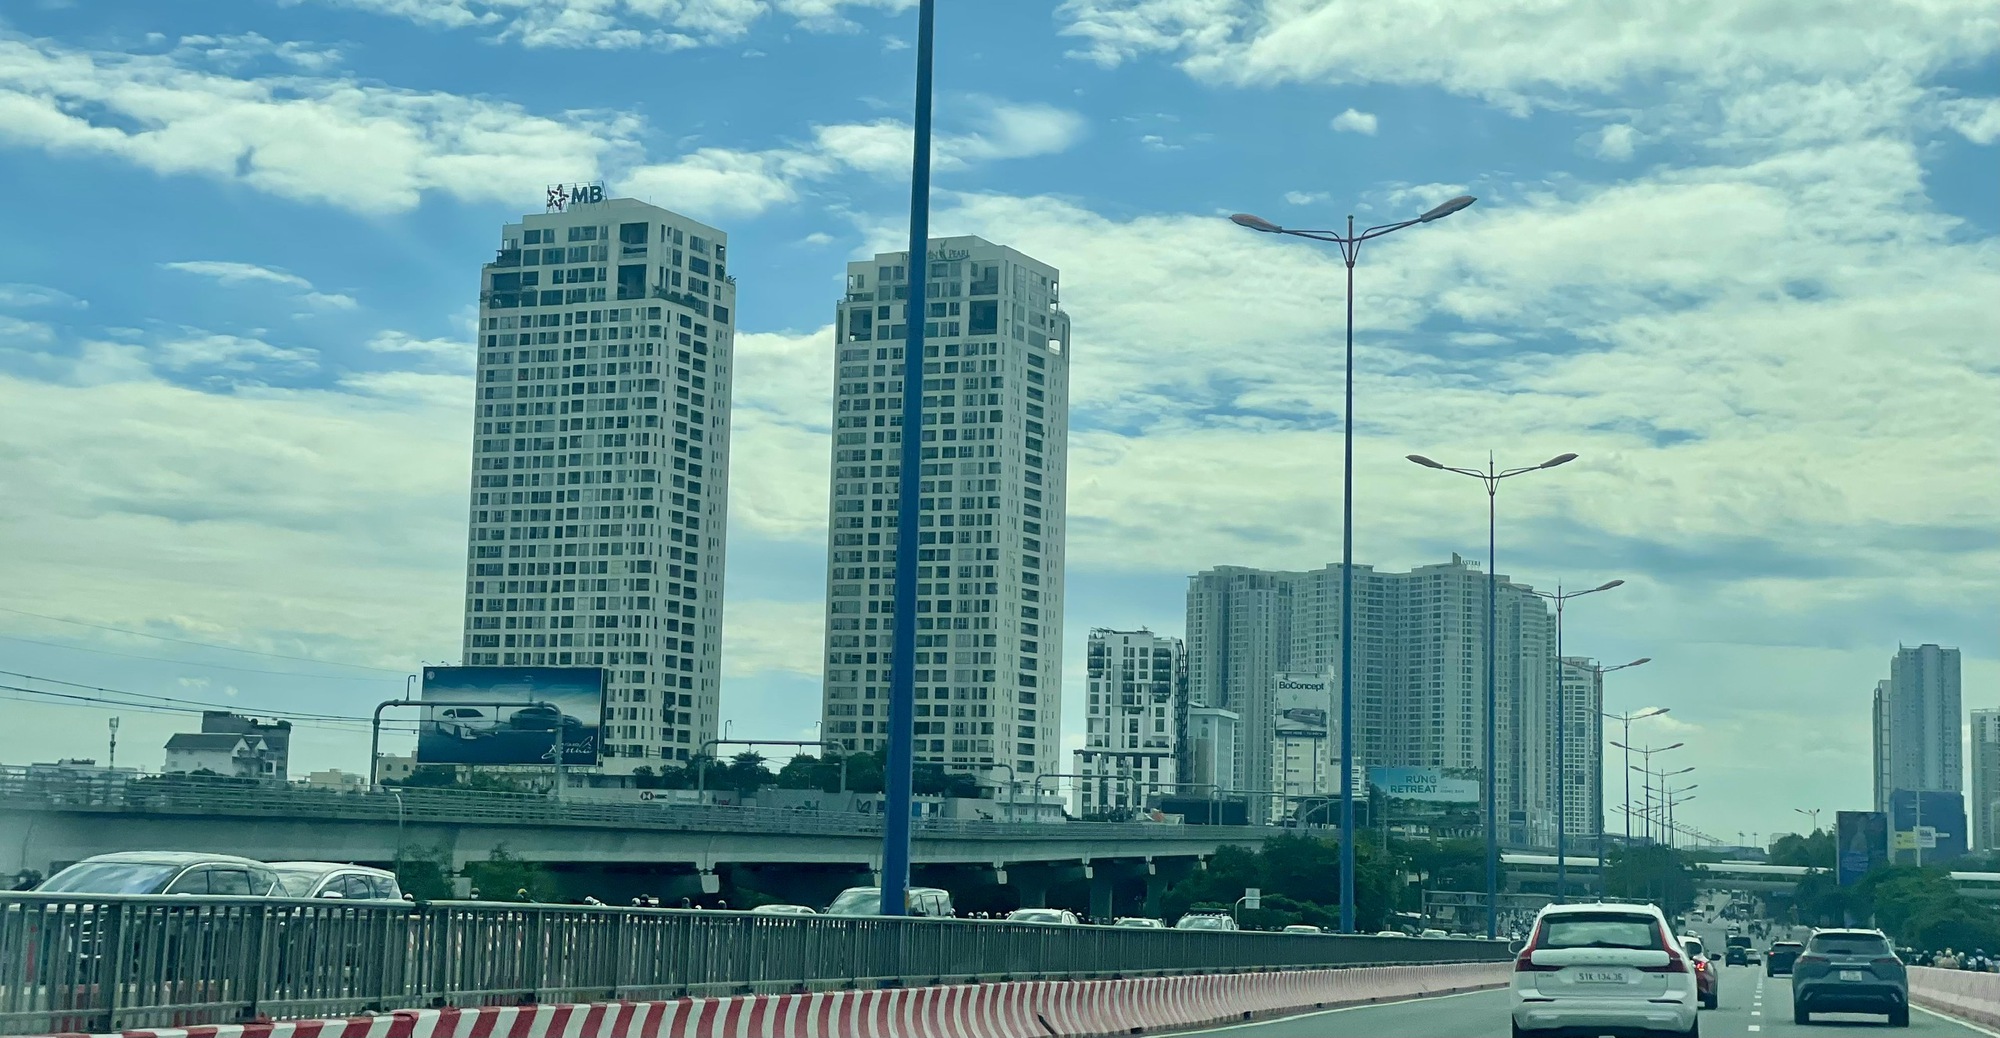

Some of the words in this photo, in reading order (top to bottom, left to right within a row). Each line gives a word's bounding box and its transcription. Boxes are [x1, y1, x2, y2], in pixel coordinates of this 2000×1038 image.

[571, 185, 603, 205] MB
[948, 248, 970, 259] PEARL
[1279, 681, 1324, 691] BoConcept
[1390, 785, 1437, 793] RETREAT
